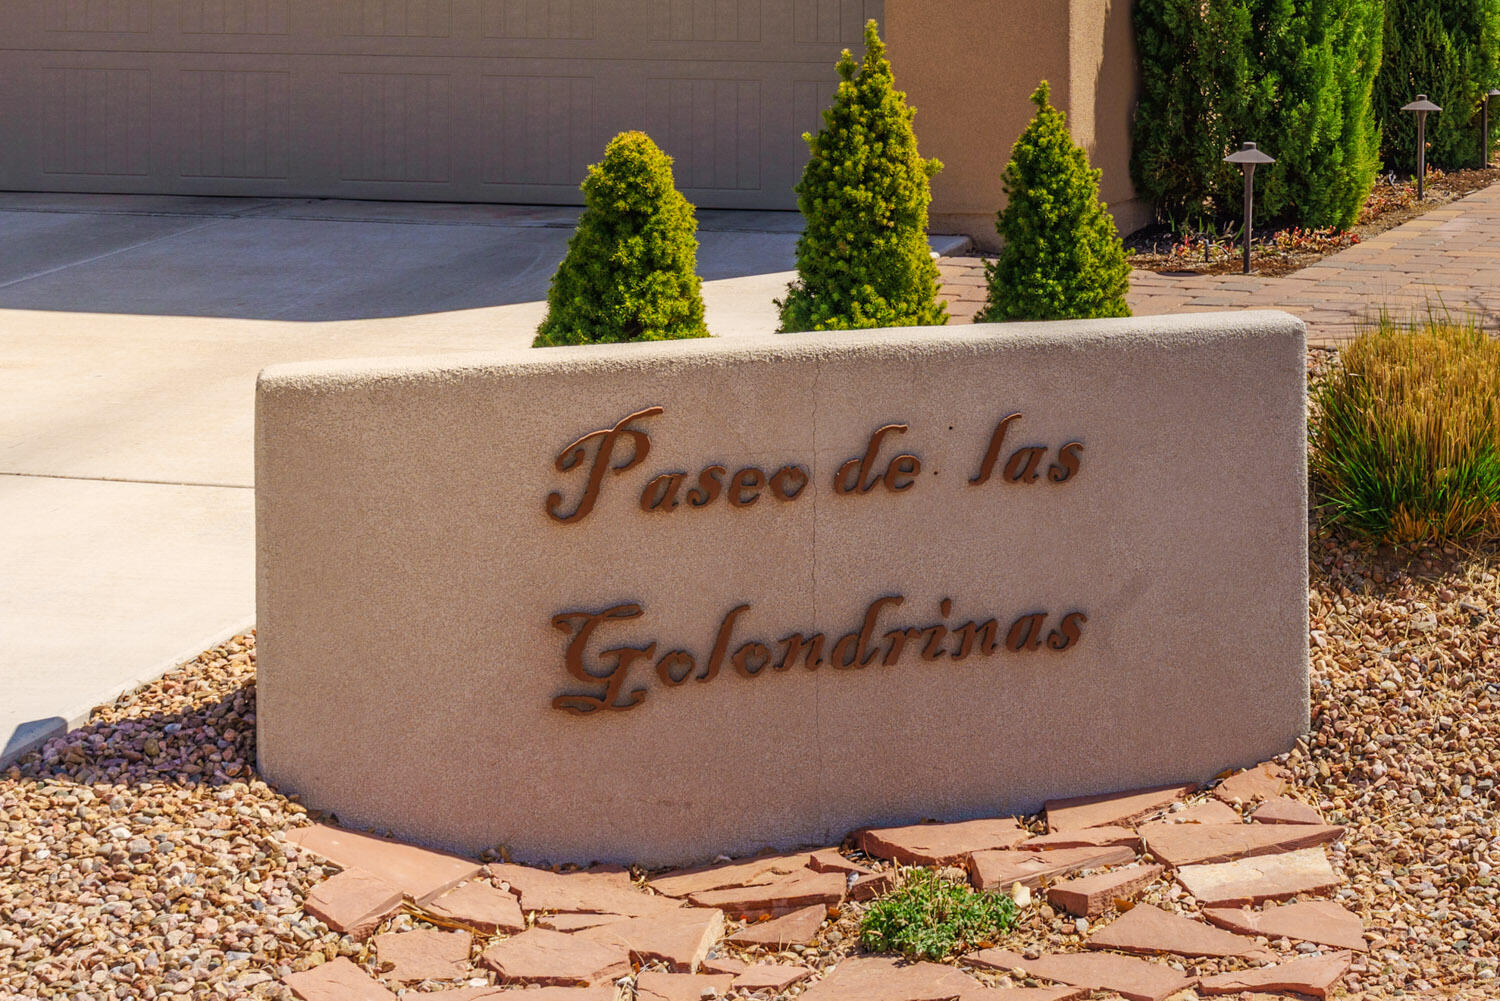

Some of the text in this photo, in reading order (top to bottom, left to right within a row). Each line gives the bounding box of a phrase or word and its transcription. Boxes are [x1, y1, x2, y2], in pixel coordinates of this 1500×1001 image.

[546, 406, 1084, 524] Paseo de las
[551, 596, 1088, 716] Golondrinas
